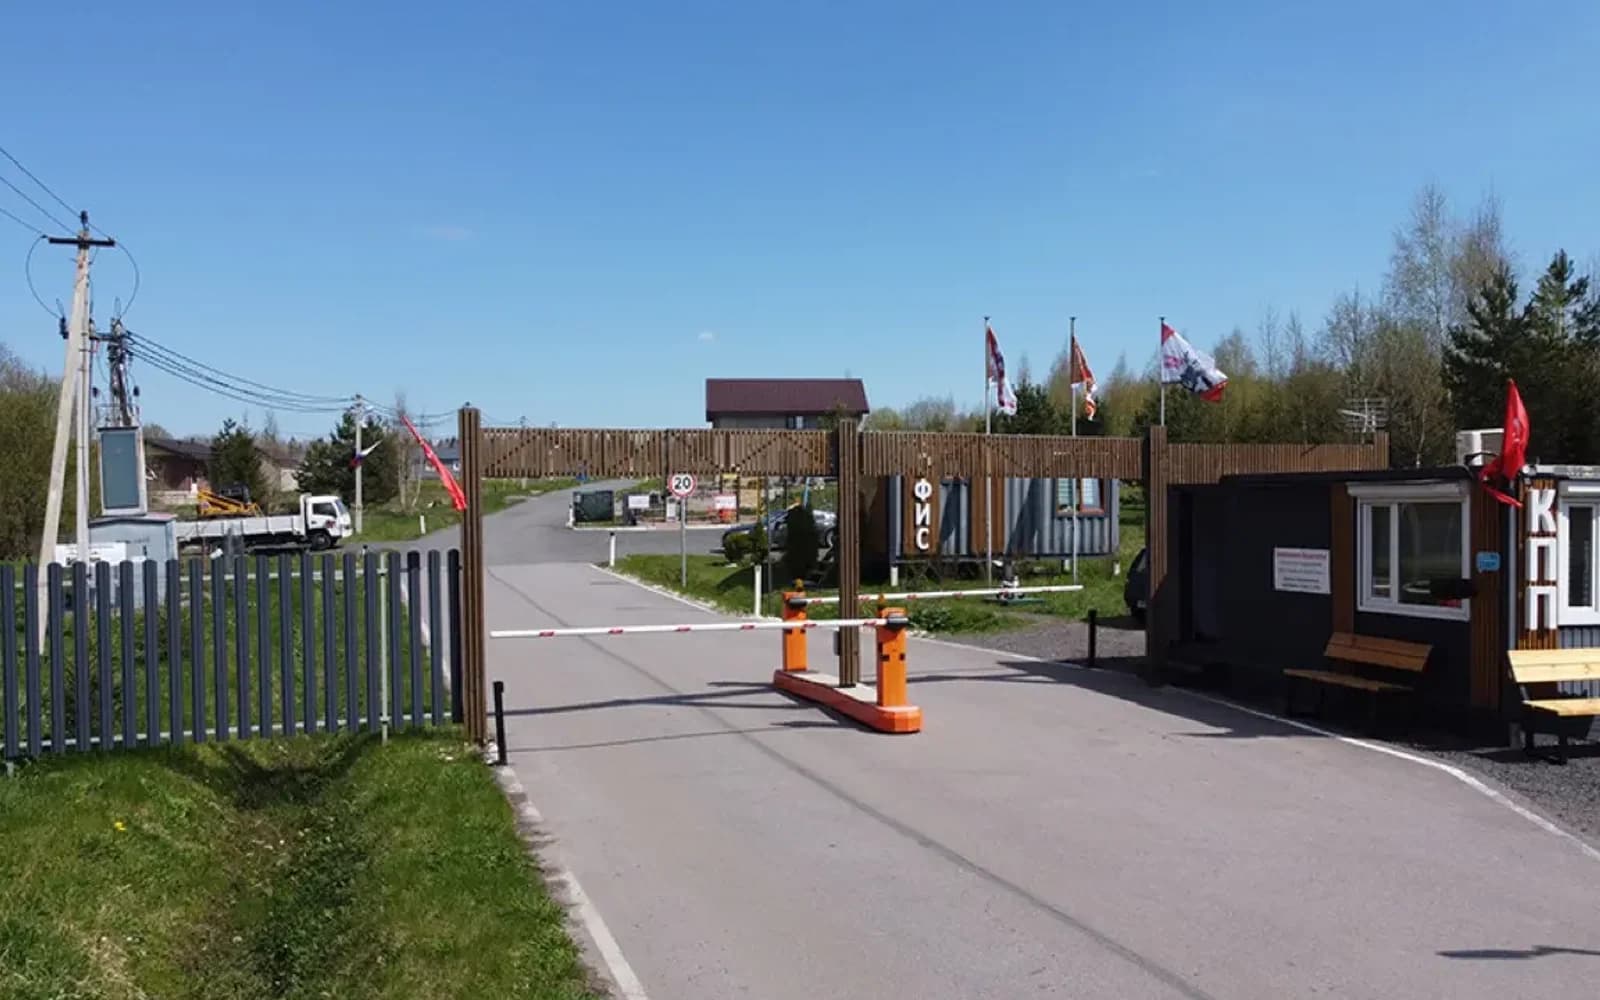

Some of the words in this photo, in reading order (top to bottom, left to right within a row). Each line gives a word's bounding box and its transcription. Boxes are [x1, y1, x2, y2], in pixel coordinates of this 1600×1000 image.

[674, 476, 691, 490] 20
[914, 454, 932, 550] ФИС
[1526, 488, 1558, 631] КПП
